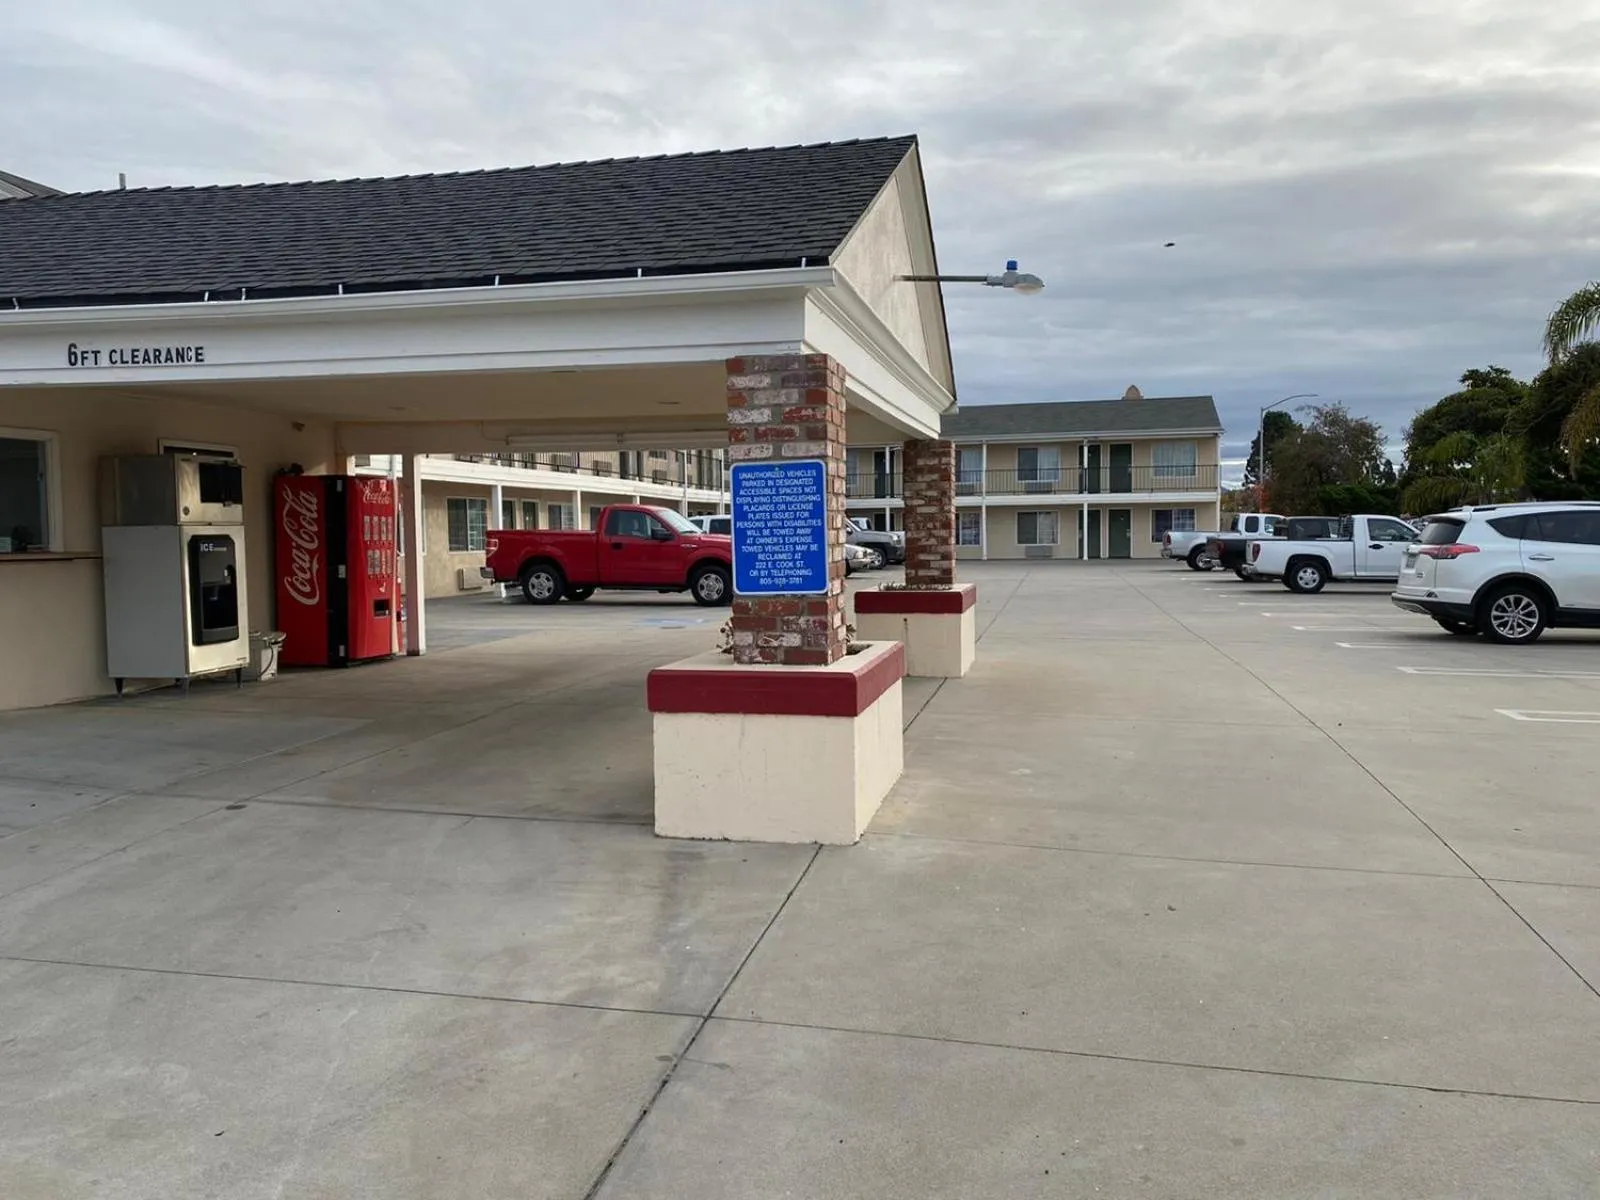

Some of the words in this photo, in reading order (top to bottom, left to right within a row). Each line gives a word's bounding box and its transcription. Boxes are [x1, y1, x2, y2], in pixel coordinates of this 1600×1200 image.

[67, 342, 101, 366] 6FT
[109, 346, 205, 365] CLEARANCE
[739, 471, 785, 479] UNAUTHORIZED
[736, 496, 770, 504] DISPLAYING
[773, 495, 821, 503] DISTINGUISHING
[200, 543, 215, 552] ICE
[283, 484, 320, 606] Coca-Cola
[771, 568, 812, 576] TELEPHONING
